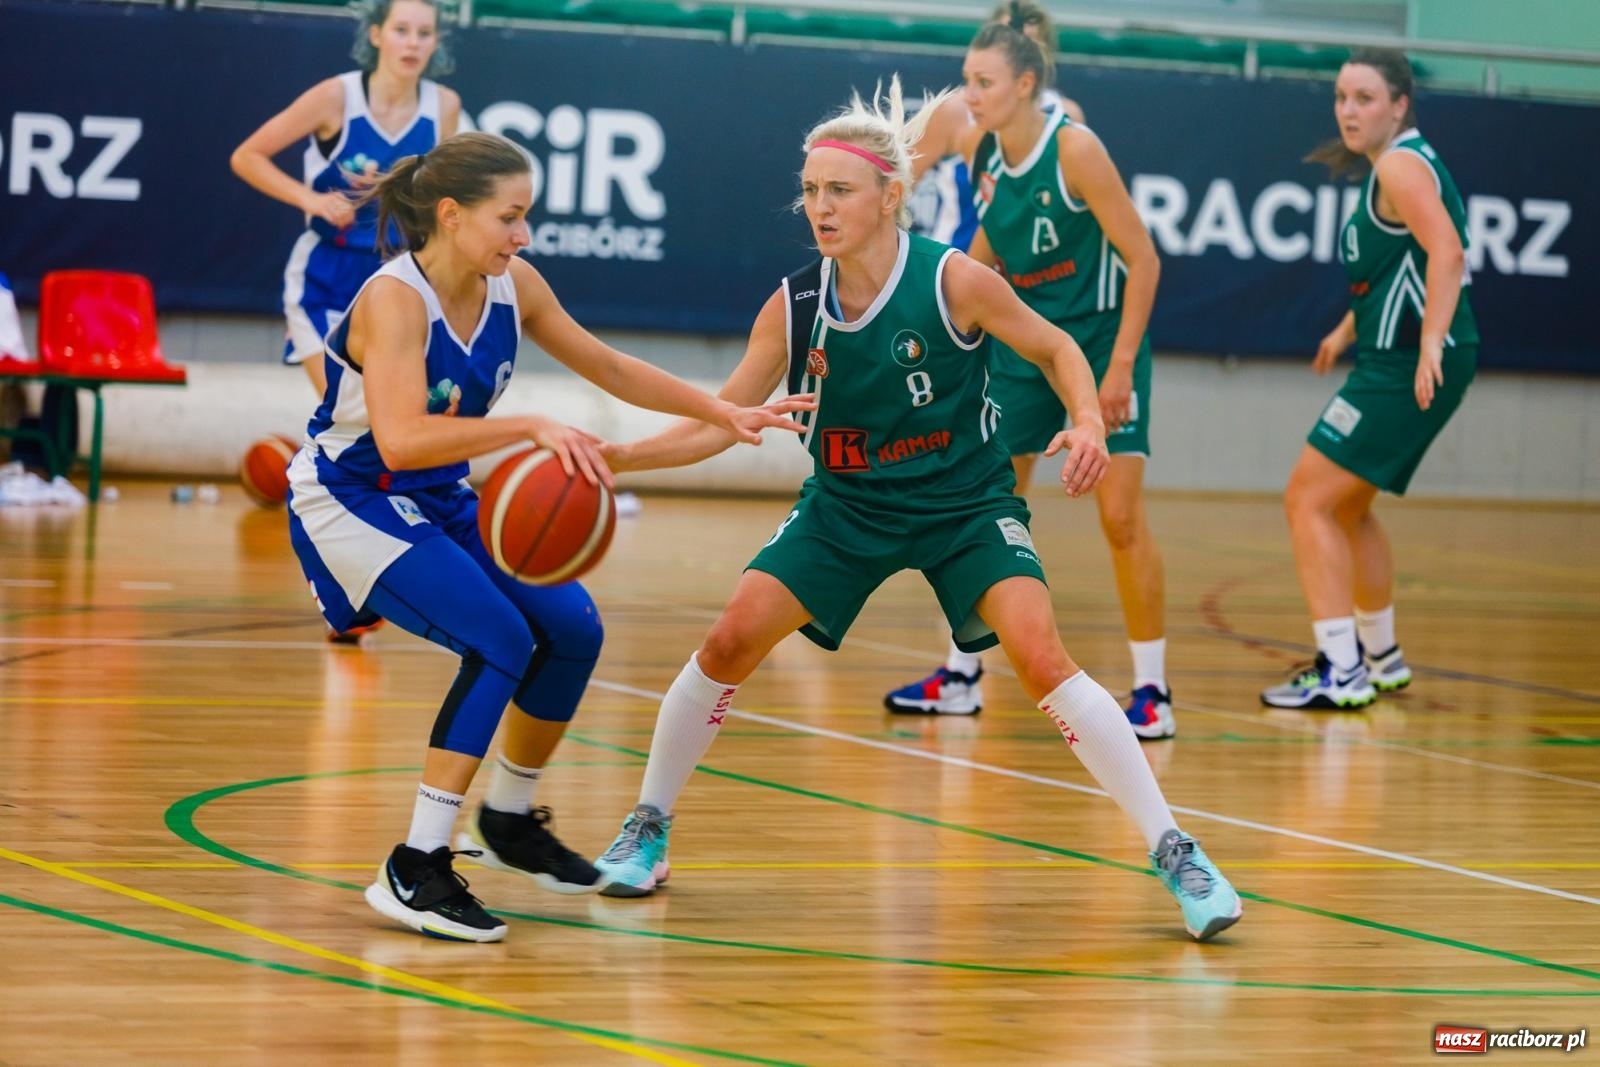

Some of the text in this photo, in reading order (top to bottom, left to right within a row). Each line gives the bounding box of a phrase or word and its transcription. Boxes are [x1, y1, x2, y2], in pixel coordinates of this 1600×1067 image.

[0, 111, 143, 201] RZ
[460, 100, 666, 221] SiR
[1032, 216, 1060, 255] 13
[1131, 173, 1572, 278] RACIRZ
[906, 371, 934, 407] 8
[825, 432, 867, 468] K
